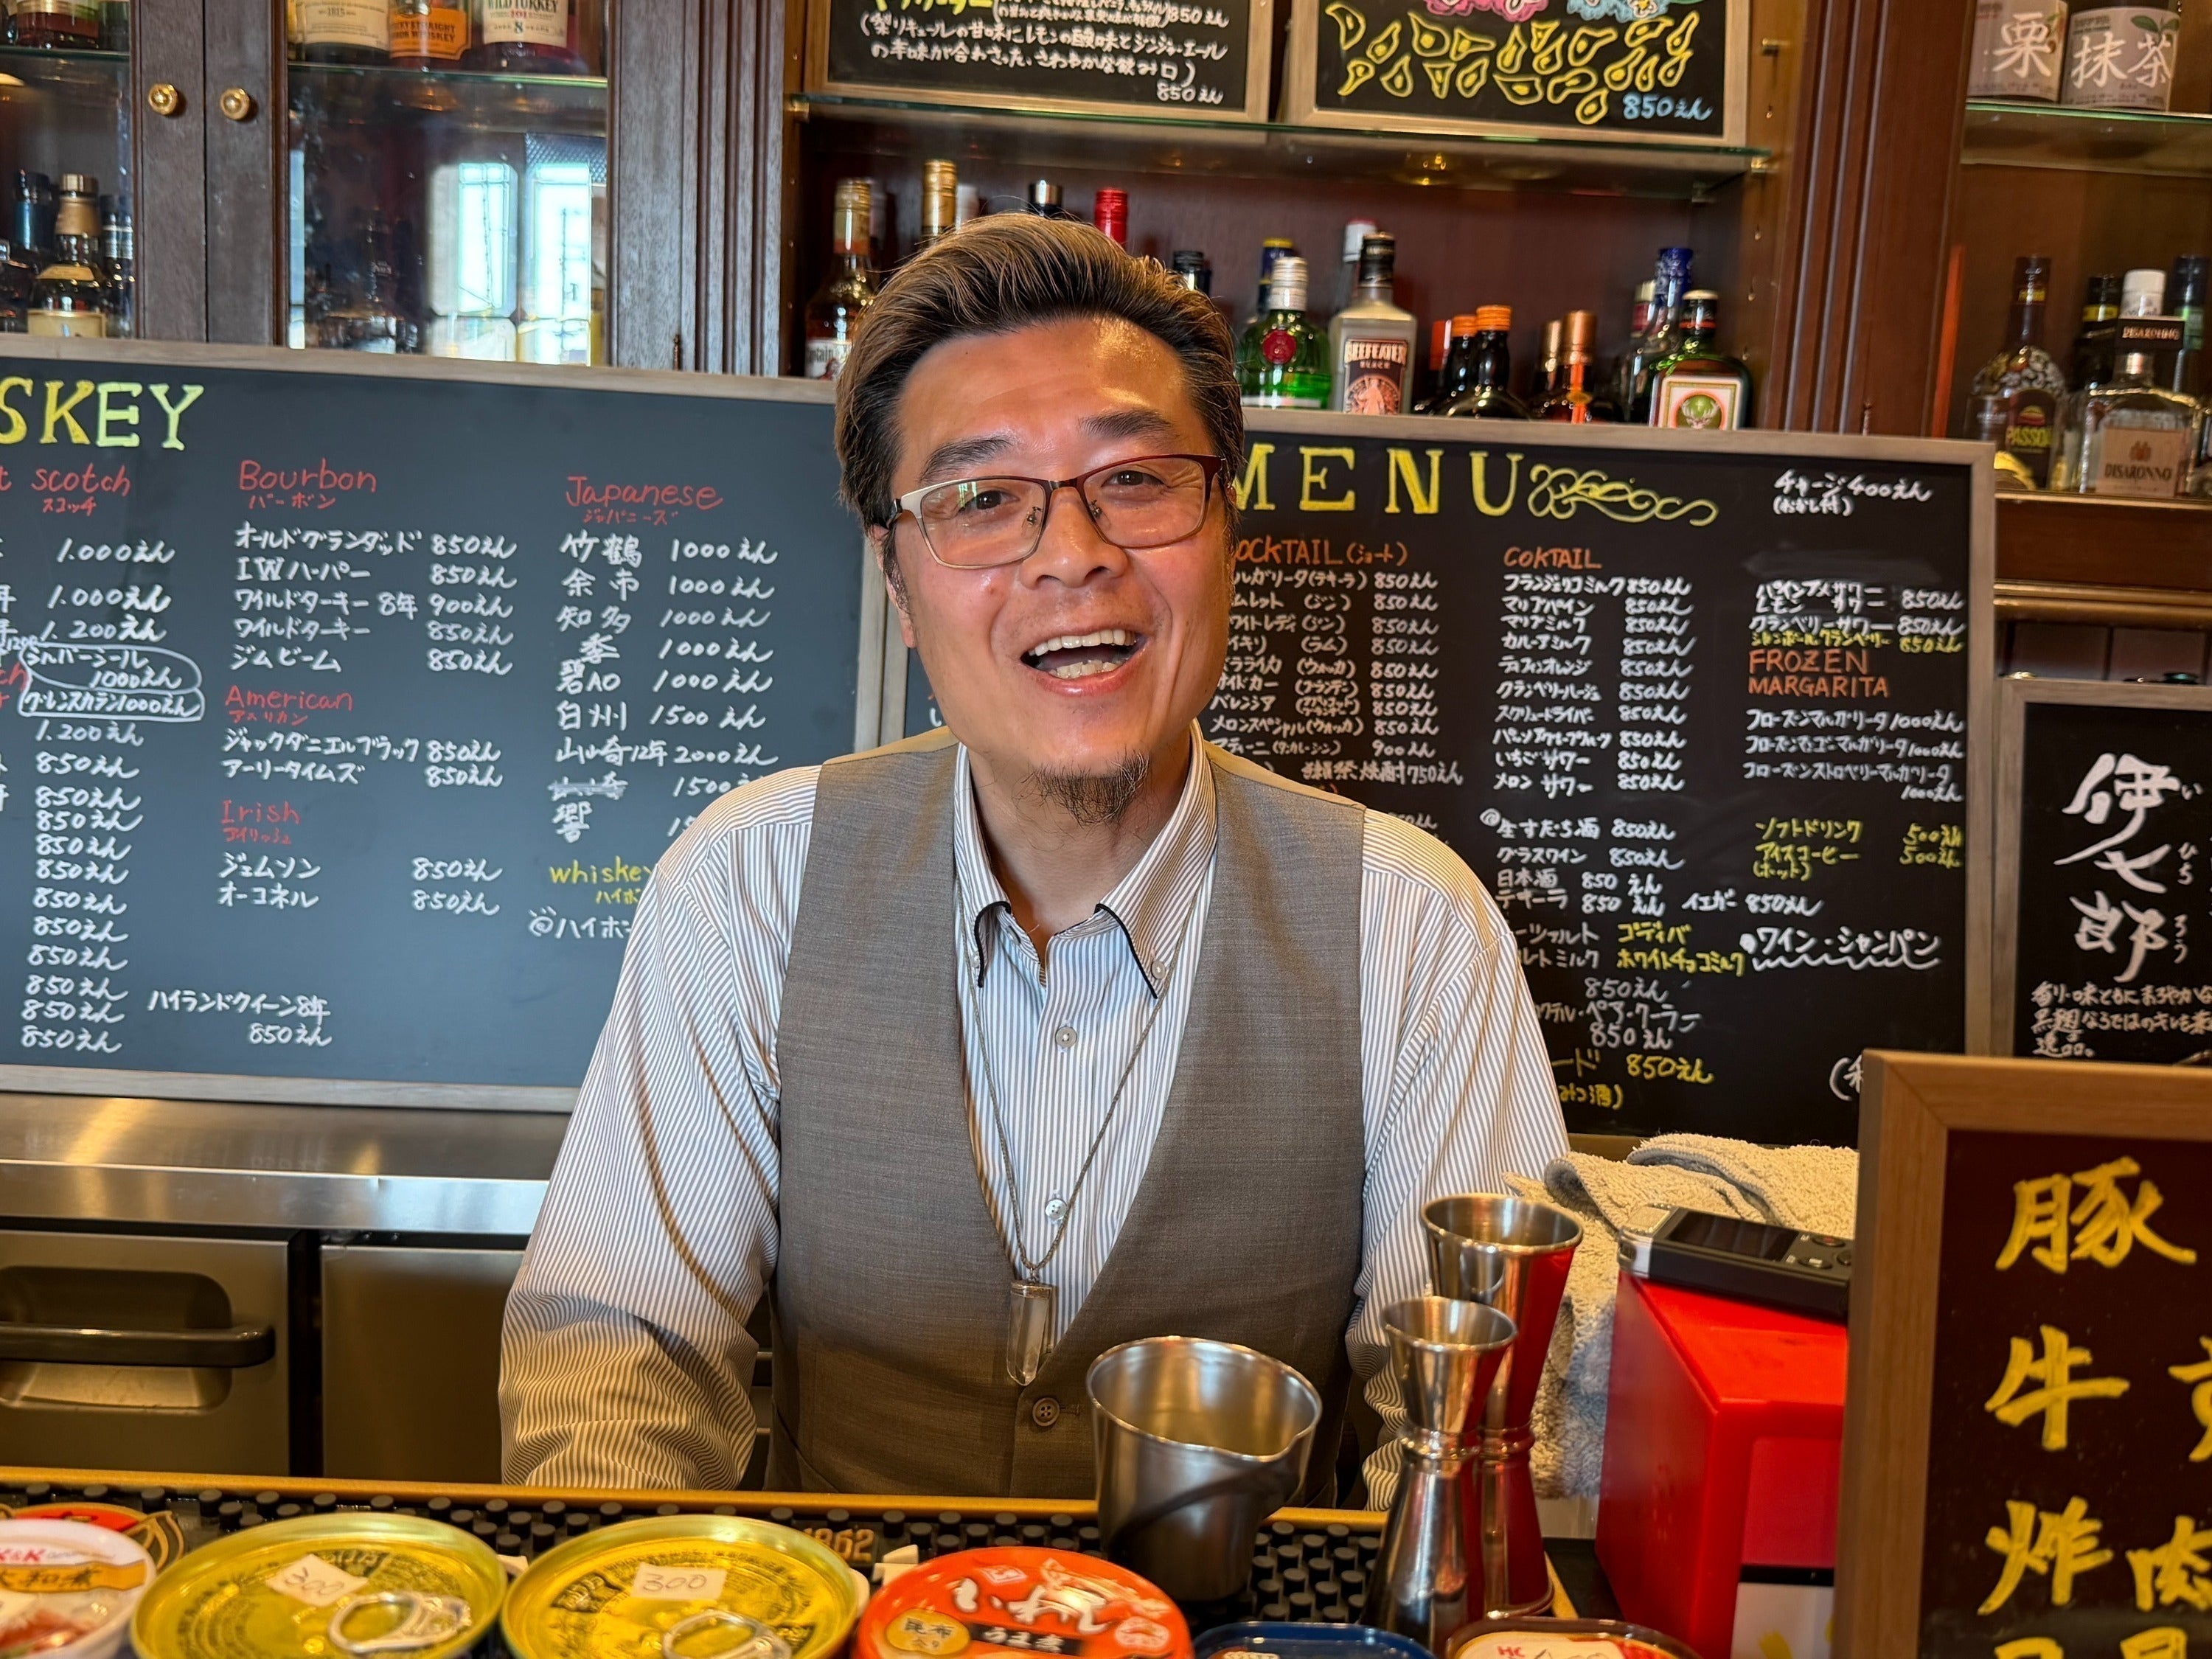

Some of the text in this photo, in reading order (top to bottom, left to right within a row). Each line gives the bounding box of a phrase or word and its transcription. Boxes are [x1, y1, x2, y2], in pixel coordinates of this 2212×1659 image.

[1992, 11, 2053, 79] 栗
[2070, 32, 2172, 88] 抹茶
[240, 459, 377, 493] Bourbon
[1234, 442, 1524, 516] MENU
[566, 476, 723, 510] Japanese
[560, 529, 779, 568] 竹鶴 1000えん
[561, 568, 776, 601] 余市 1000えん
[234, 588, 369, 616] ワイルドターキー
[233, 616, 372, 642] ワイルドターキー
[556, 605, 772, 634] 知多 1000えん
[229, 644, 342, 672] ジムビーム
[658, 637, 774, 664] 1000えん
[1748, 648, 1869, 675] FROZEN
[653, 667, 773, 694] 1000えん
[1747, 675, 1892, 698] MARGARITA
[226, 685, 354, 712] American
[556, 700, 766, 731] 白州 1500えん
[220, 799, 302, 826] Irish
[1754, 816, 1864, 844] ソフトドリンク
[218, 852, 321, 880] ジェムソン
[1497, 846, 1587, 865] グラスワイン
[1754, 841, 1863, 866] アイスコーヒー
[1497, 867, 1559, 889] 日本酒
[2053, 752, 2181, 984] 伊七郎
[218, 881, 320, 910] オーコネル
[1495, 888, 1569, 910] テキーラ
[1995, 1155, 2197, 1274] 豚
[284, 1565, 345, 1597] 300
[641, 1572, 708, 1593] 300
